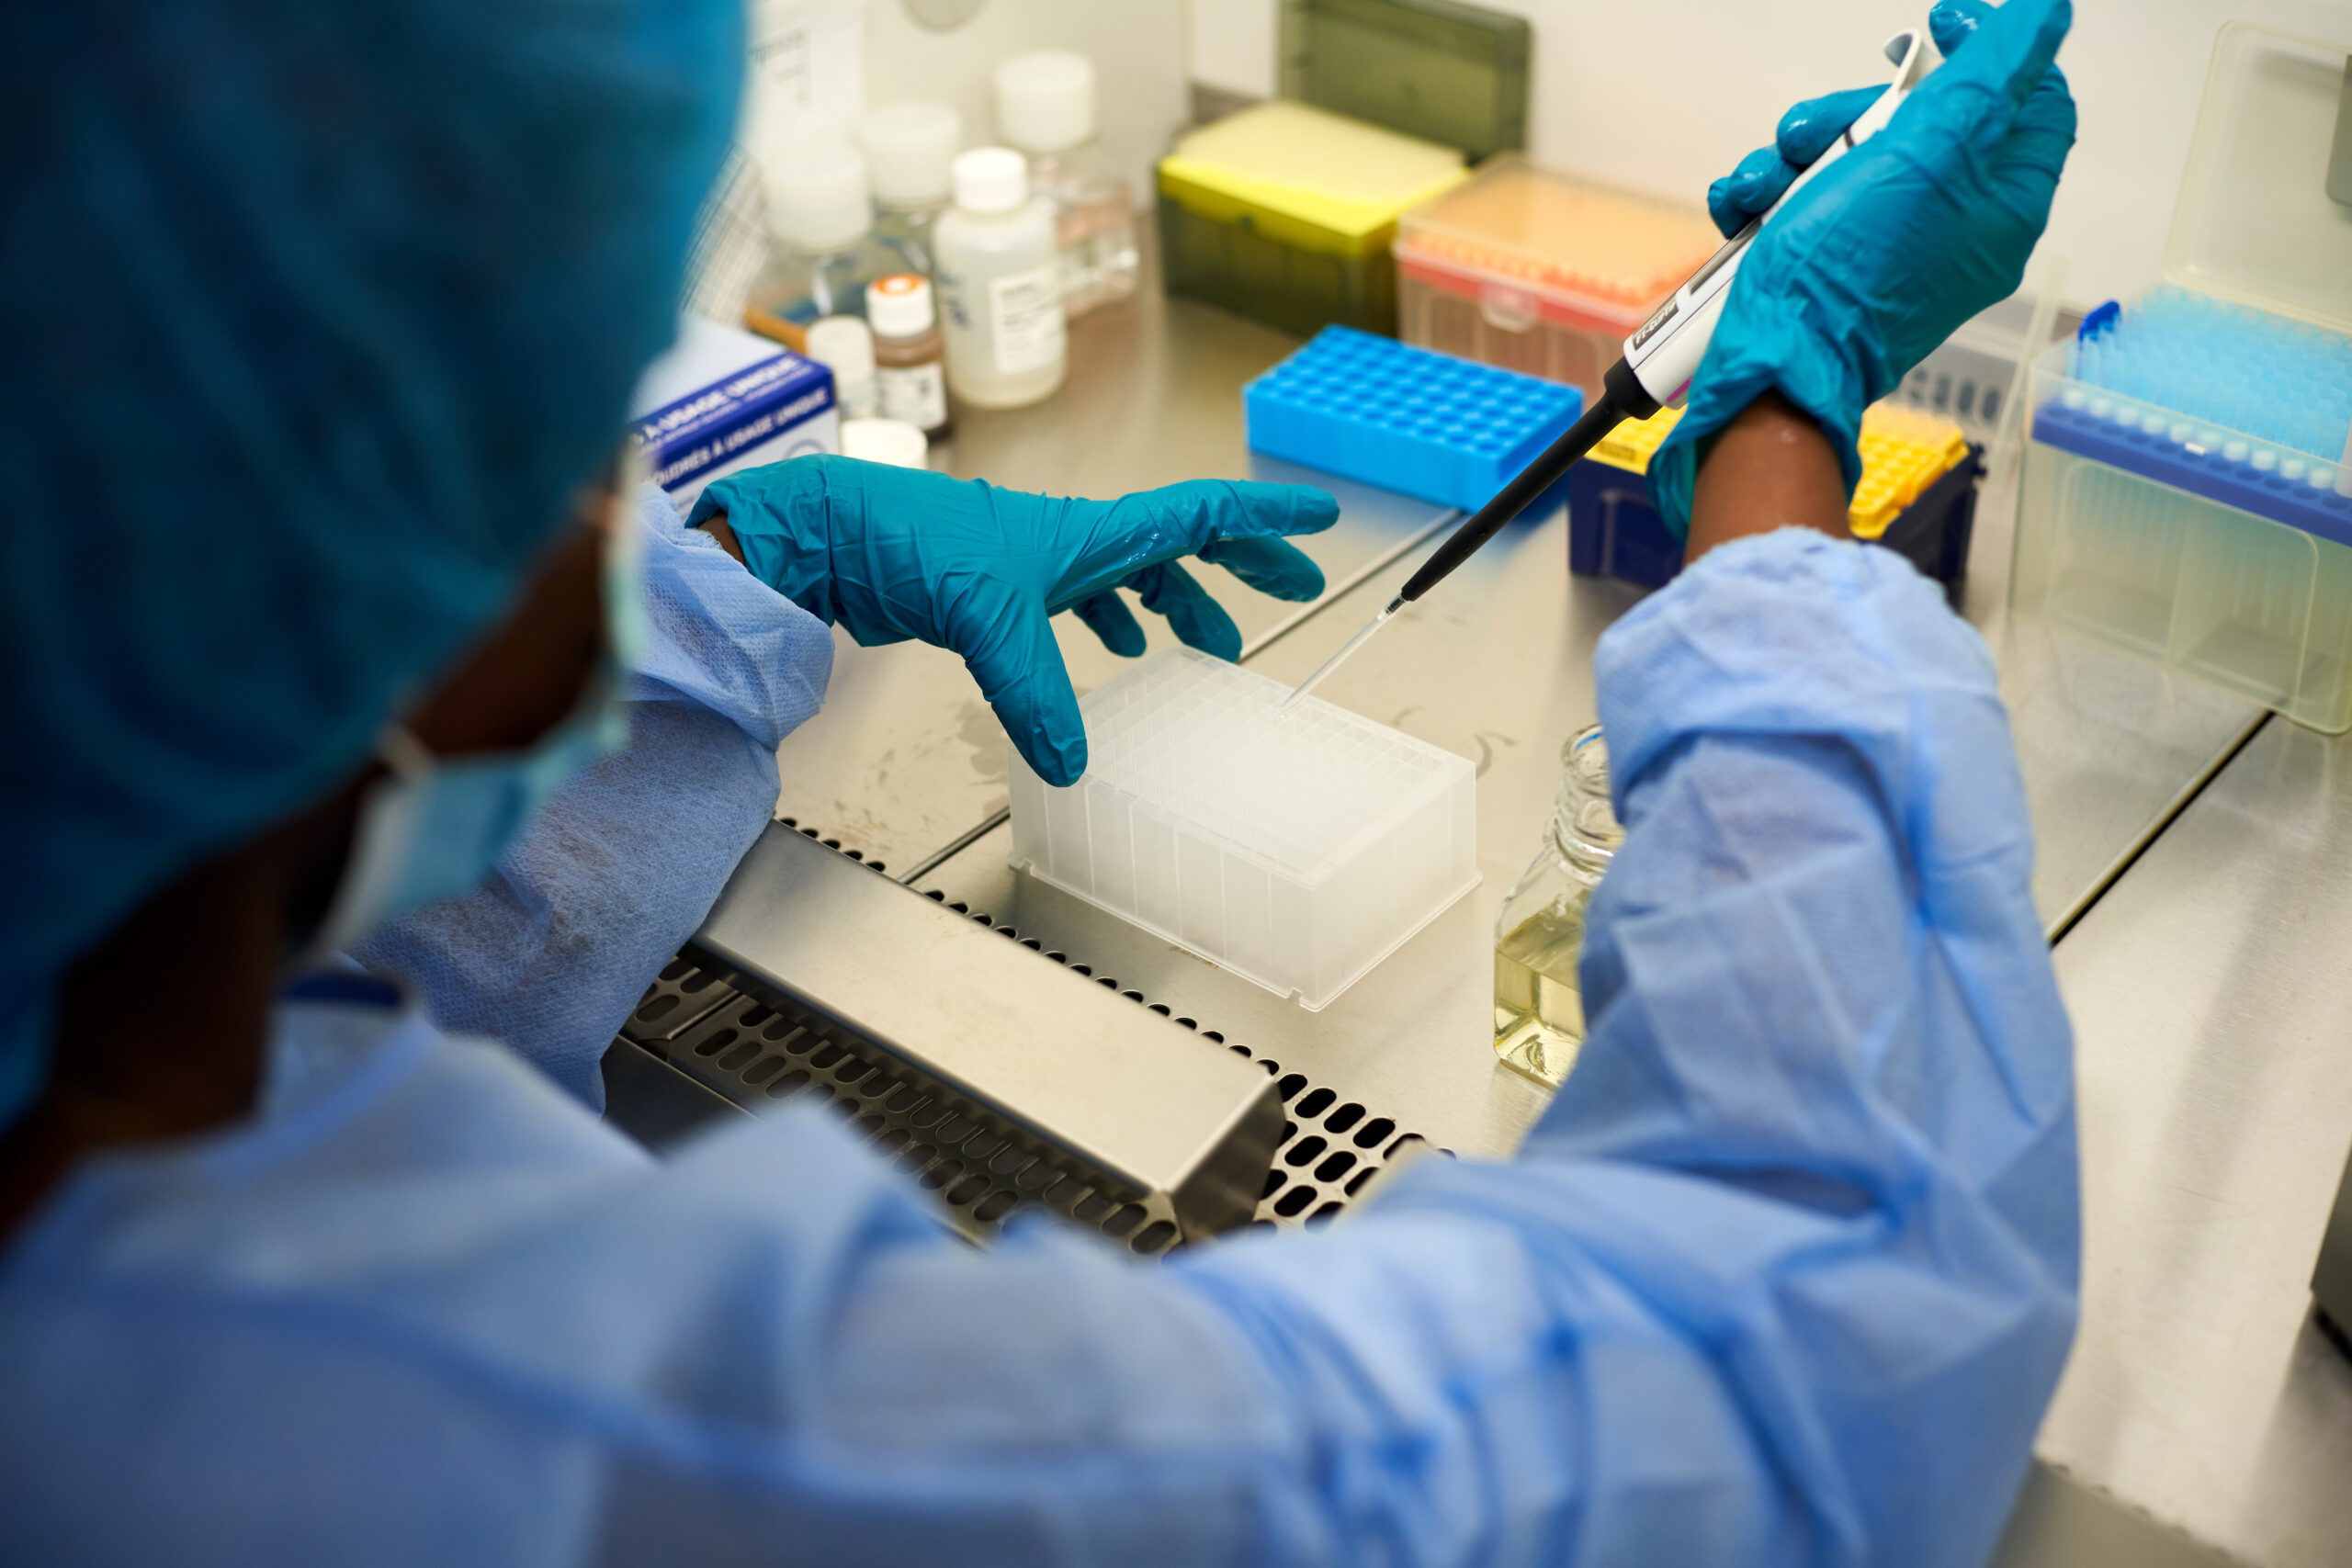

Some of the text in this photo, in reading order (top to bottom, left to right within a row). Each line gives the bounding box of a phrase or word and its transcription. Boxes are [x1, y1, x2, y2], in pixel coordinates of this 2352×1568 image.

[647, 446, 711, 488] OUDRÉS
[723, 413, 775, 452] USAGE
[775, 386, 829, 426] UNIQUE
[658, 390, 730, 431] USAGE
[725, 356, 801, 398] UNIQUE
